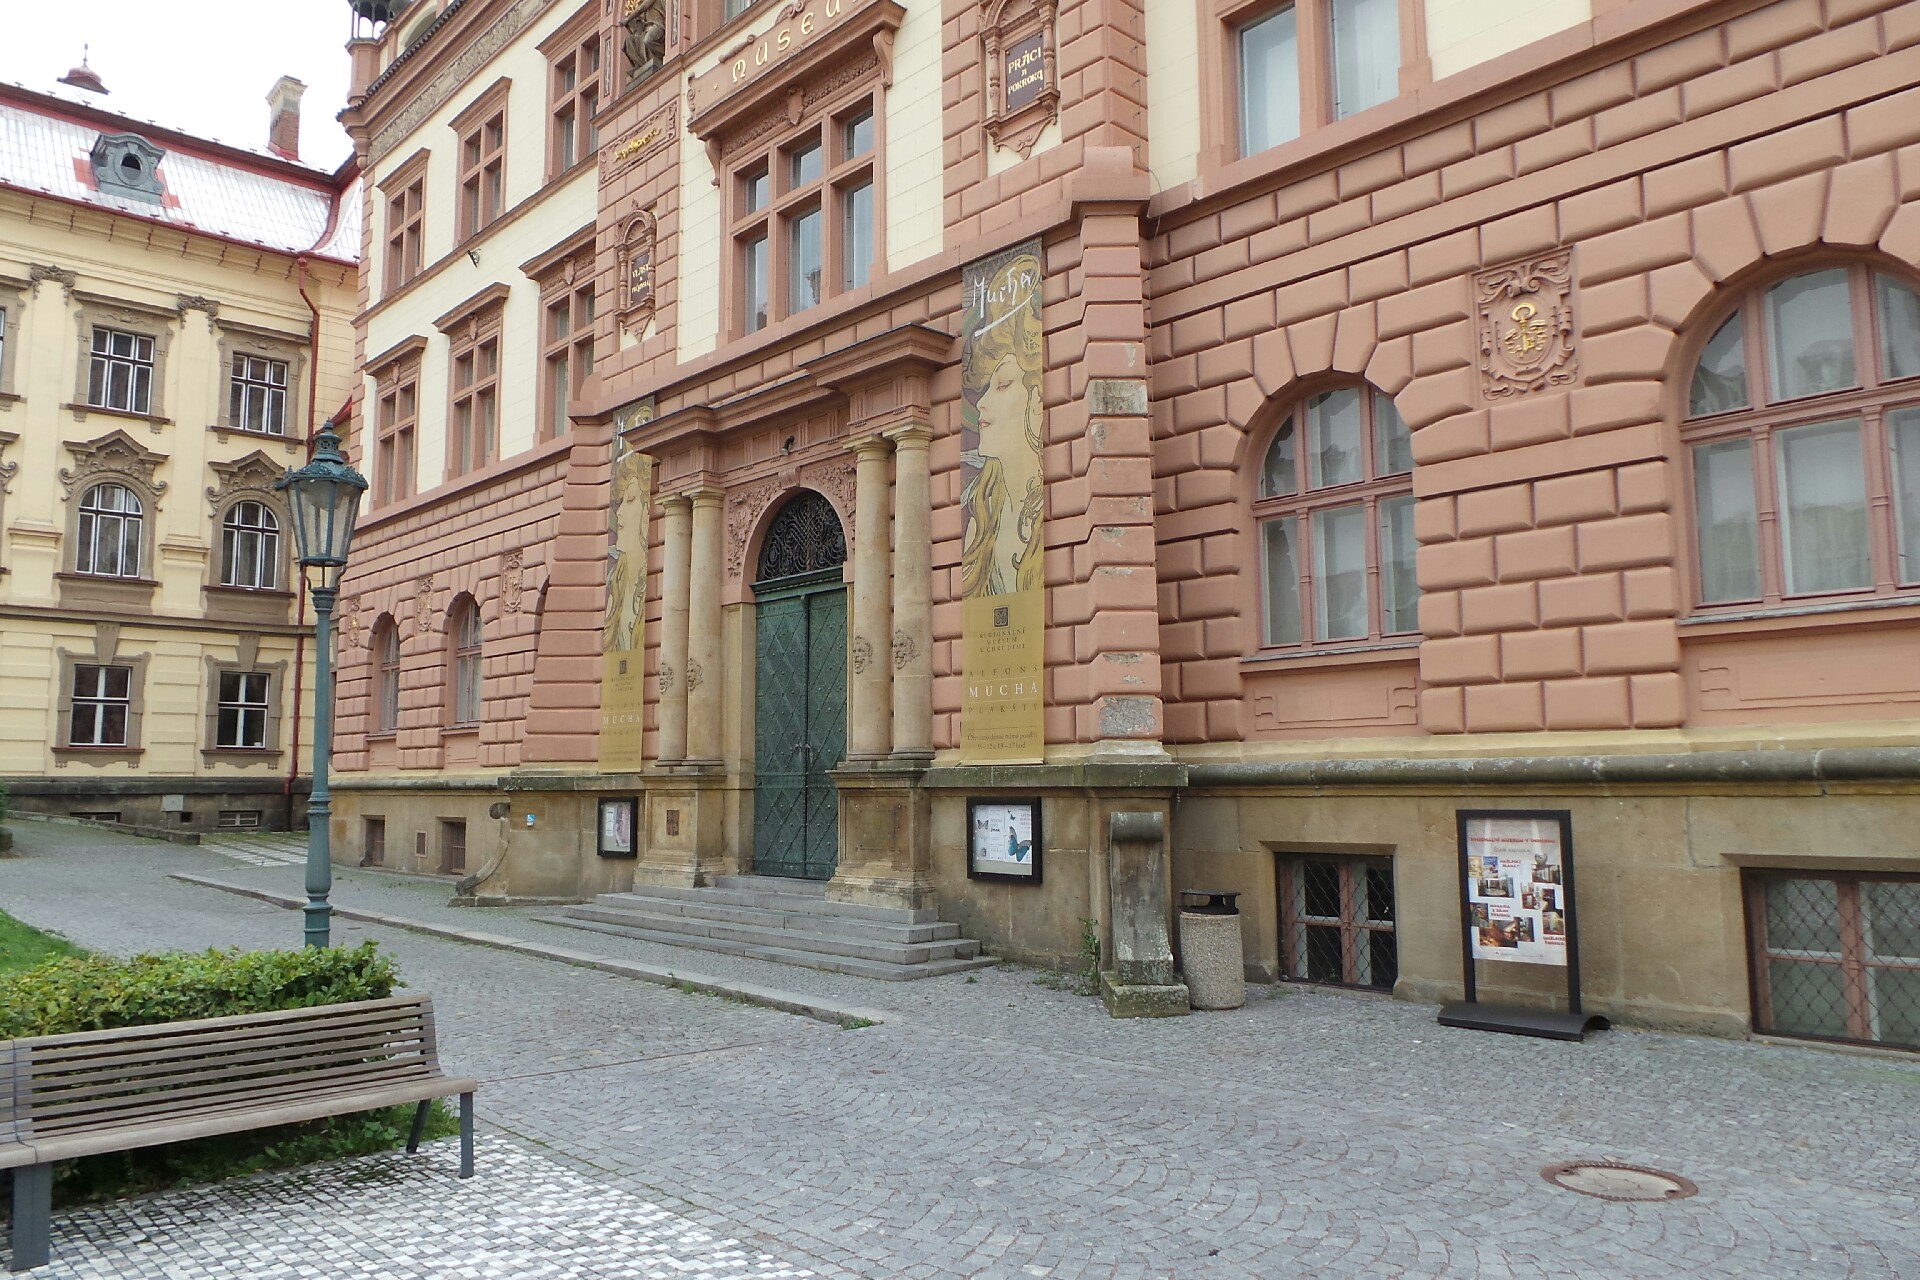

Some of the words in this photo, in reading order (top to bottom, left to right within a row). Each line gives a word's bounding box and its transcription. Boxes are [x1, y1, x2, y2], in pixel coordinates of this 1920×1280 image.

[732, 0, 855, 83] MUSEU
[969, 681, 1038, 698] MUCHA
[603, 713, 640, 725] MUCHA
